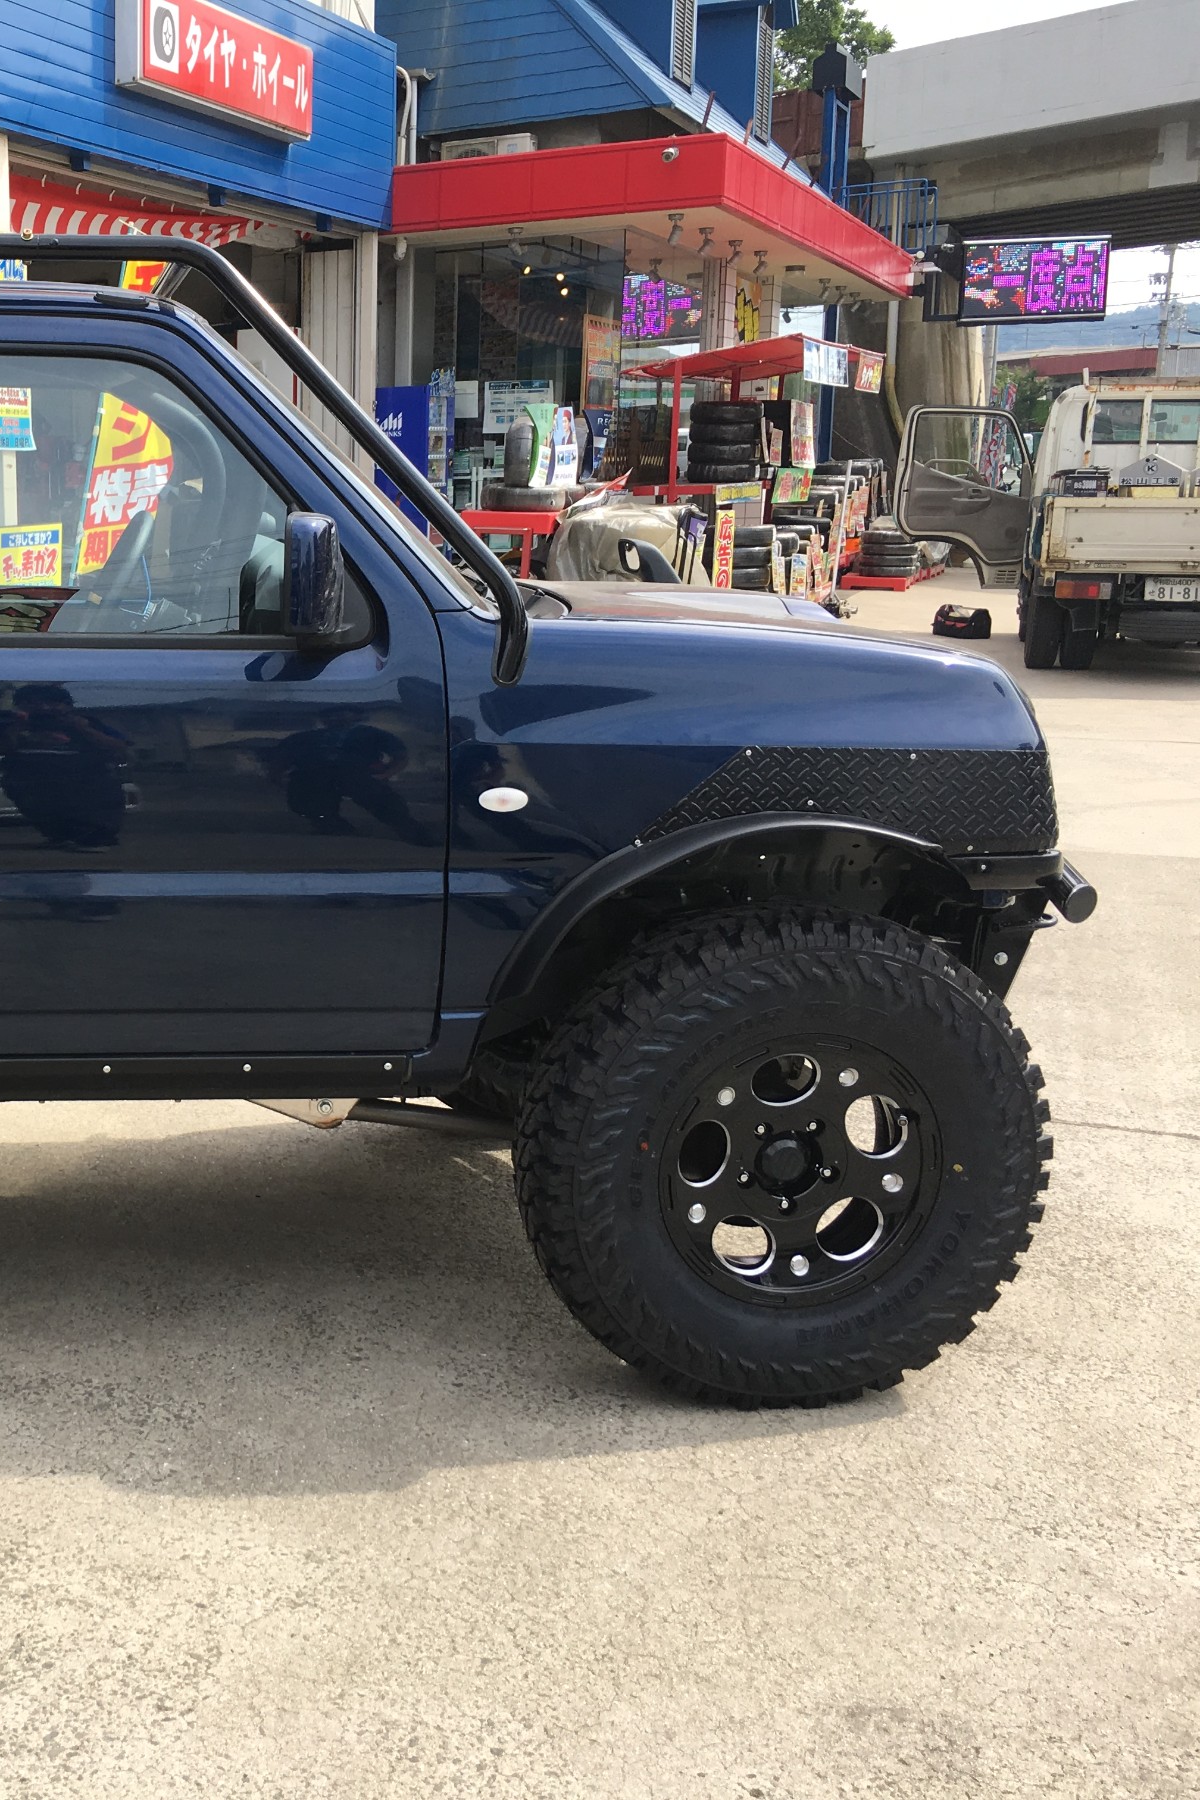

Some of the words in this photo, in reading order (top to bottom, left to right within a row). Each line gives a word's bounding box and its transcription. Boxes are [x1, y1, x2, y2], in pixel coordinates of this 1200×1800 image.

[185, 14, 309, 113] タイヤ・ホイール
[992, 244, 1107, 311] 一度点
[376, 411, 403, 431] ahi
[2, 547, 57, 579] チッ素ガス
[1157, 587, 1199, 599] 81-81
[795, 1208, 975, 1347] YOKOHAMA
